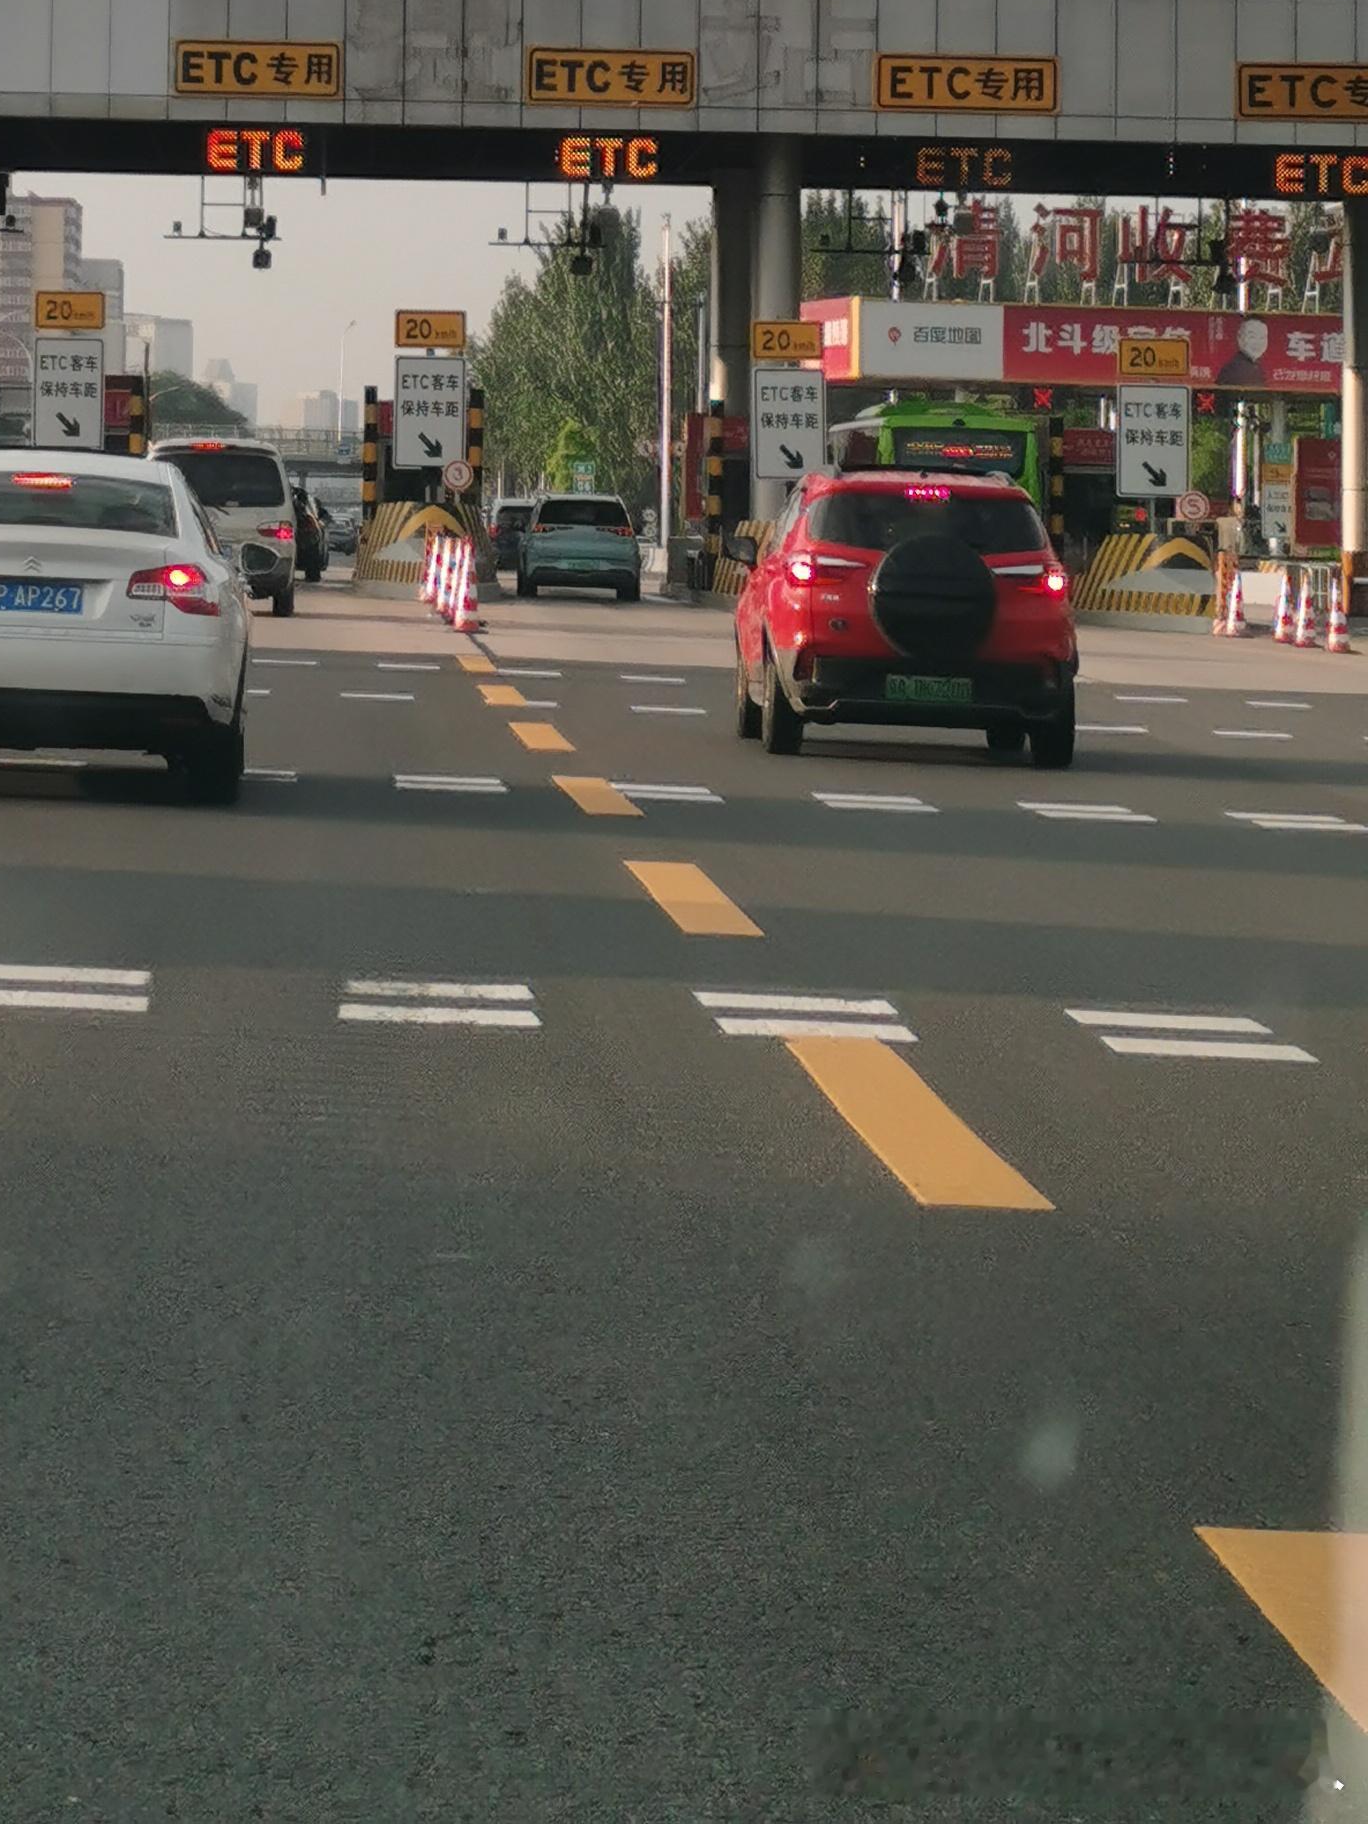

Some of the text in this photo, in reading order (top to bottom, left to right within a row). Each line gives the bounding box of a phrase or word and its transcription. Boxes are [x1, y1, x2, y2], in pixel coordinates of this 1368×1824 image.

[182, 50, 333, 86] ETC专用
[535, 58, 689, 95] ETC专用
[889, 65, 1045, 102] ETC专用
[206, 128, 304, 172] ETC
[560, 136, 659, 178] ETC
[916, 146, 1013, 187] ETC
[1275, 153, 1368, 194] ETC
[45, 299, 72, 320] 20
[405, 318, 432, 339] 20
[761, 329, 791, 351] 20
[40, 354, 98, 373] ETC客车
[1129, 346, 1156, 368] 20
[40, 381, 98, 399] 保持车距
[401, 373, 459, 391] ETC客车
[760, 385, 818, 402] ETC客车
[401, 400, 460, 418] 保持车距
[1124, 402, 1182, 419] ETC客车
[760, 412, 819, 429] 保持车距
[1125, 428, 1184, 447] 保持车距
[453, 466, 464, 482] 3
